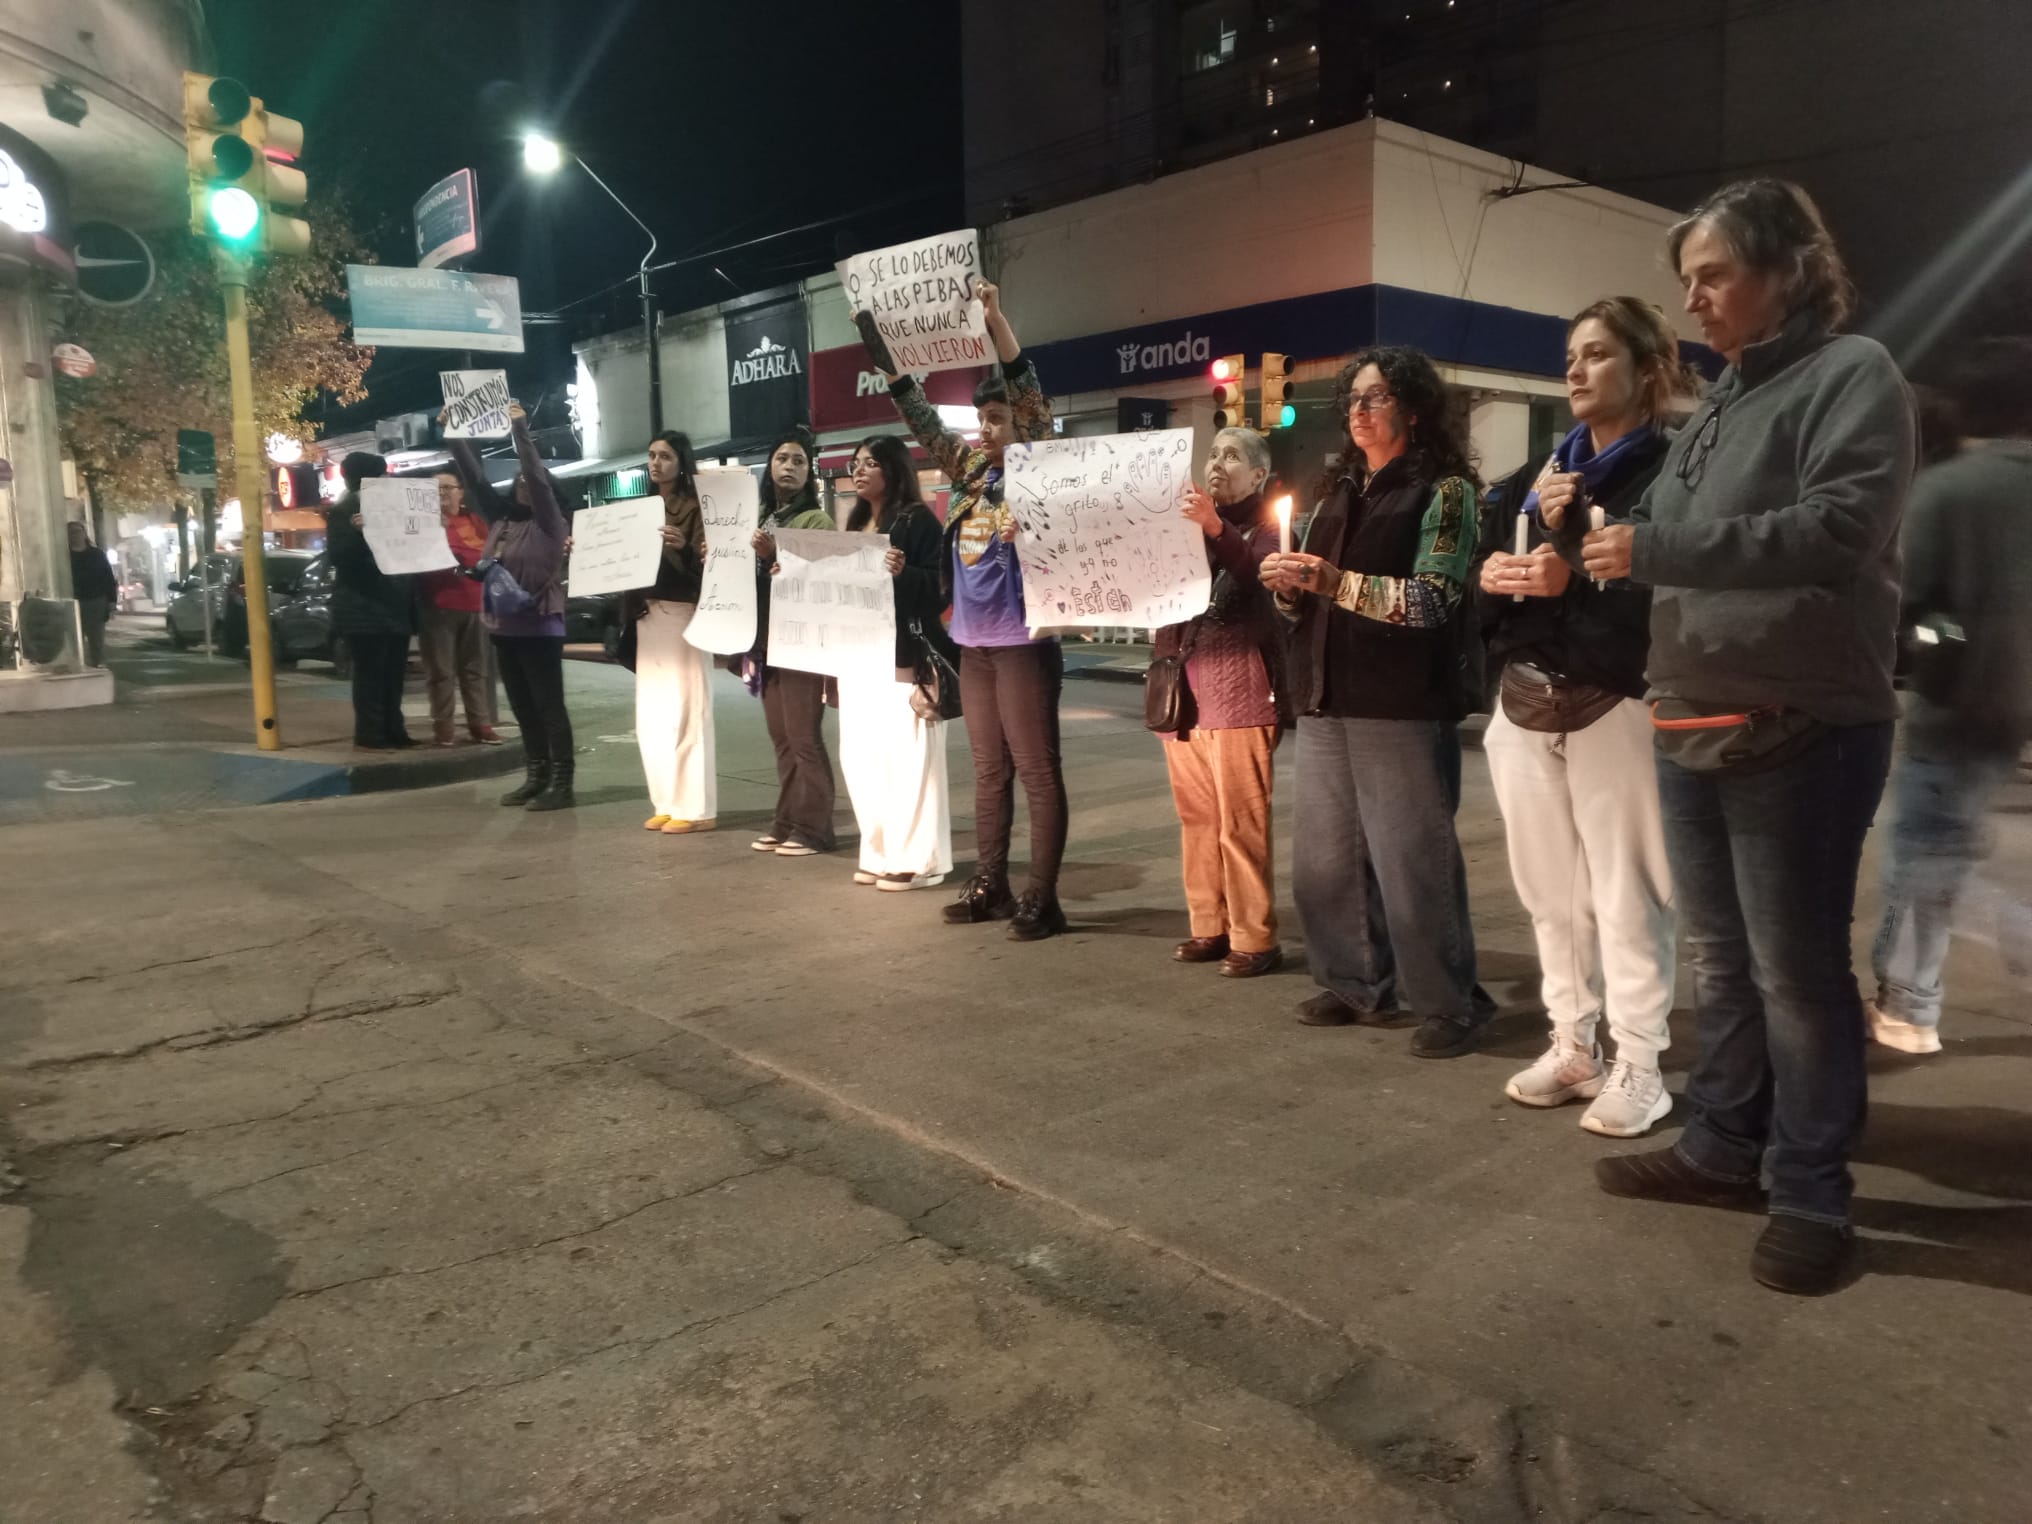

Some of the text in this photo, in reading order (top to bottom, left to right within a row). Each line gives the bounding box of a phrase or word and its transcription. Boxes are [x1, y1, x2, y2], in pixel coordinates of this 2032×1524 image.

[868, 241, 975, 287] SE LO DEBEMOS
[871, 271, 975, 316] A LAS PIBAS
[879, 309, 971, 342] QUE NUNCA
[892, 337, 986, 368] VOLVIERON
[1140, 331, 1210, 370] anda
[730, 348, 802, 387] ADHARA
[442, 373, 465, 399] NOS
[467, 407, 510, 437] JUNTAS
[1101, 463, 1113, 485] el
